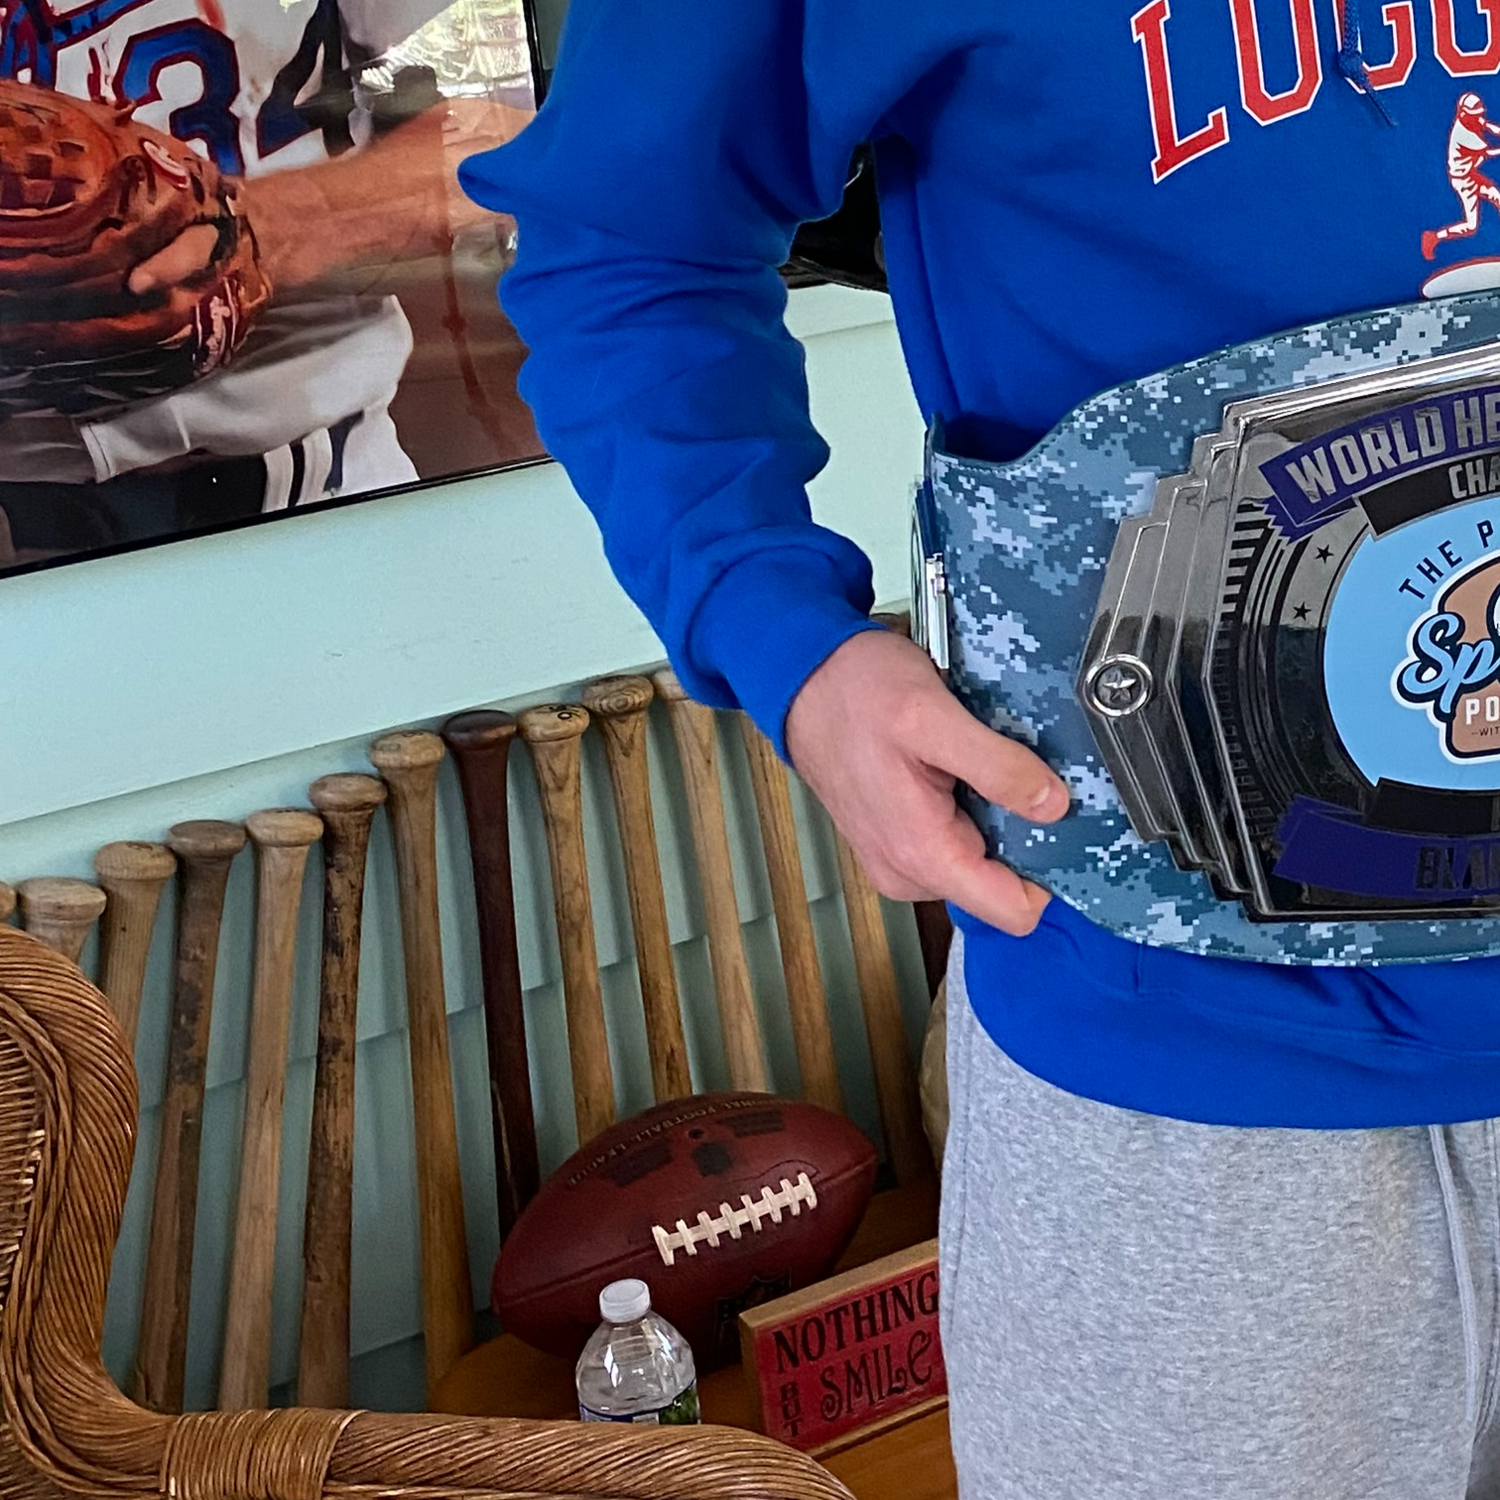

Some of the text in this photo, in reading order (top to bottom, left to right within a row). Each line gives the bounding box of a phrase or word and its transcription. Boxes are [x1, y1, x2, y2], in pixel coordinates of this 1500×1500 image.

[1285, 407, 1443, 504] WORLD
[1397, 539, 1464, 600] THE
[771, 1269, 940, 1375] NOTHING
[819, 1329, 933, 1423] SMILE
